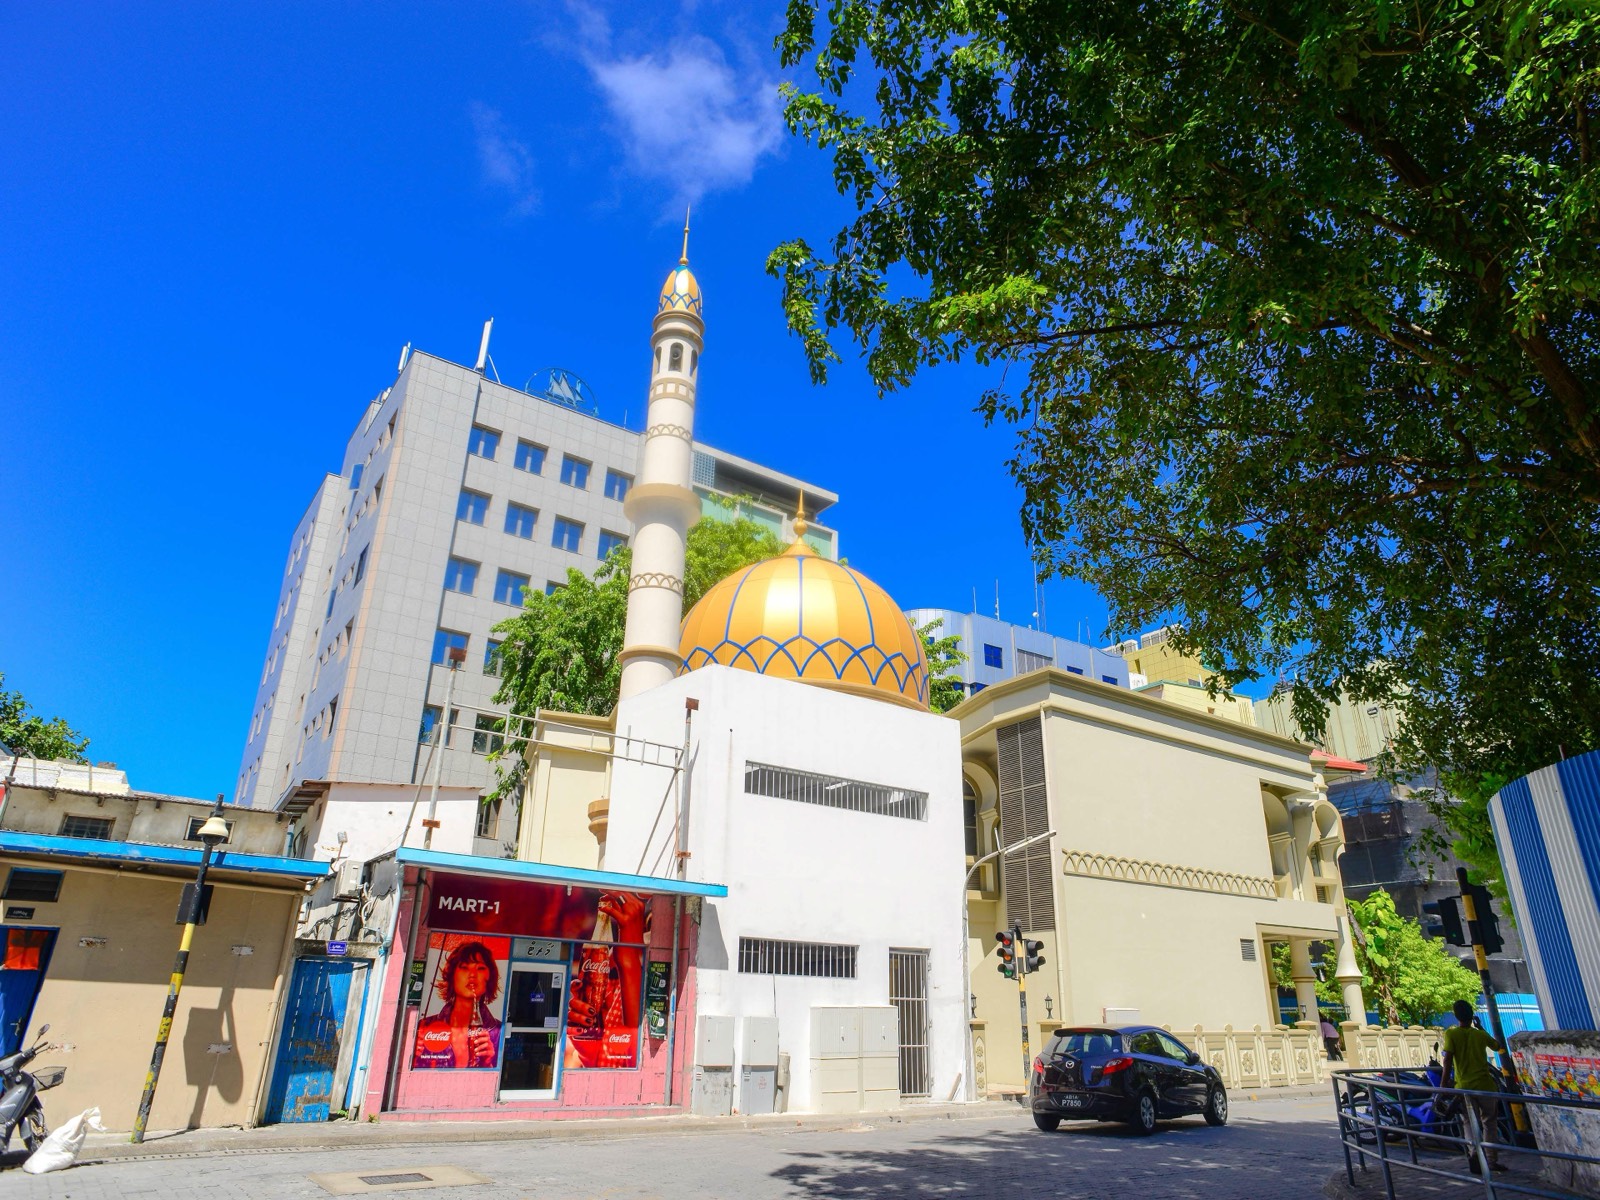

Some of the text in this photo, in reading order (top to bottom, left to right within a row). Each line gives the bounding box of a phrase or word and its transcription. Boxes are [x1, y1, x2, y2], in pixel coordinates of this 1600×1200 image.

[438, 895, 500, 915] MART-1
[425, 1031, 451, 1041] Coca-Cola
[609, 1034, 632, 1043] Coca-Cola
